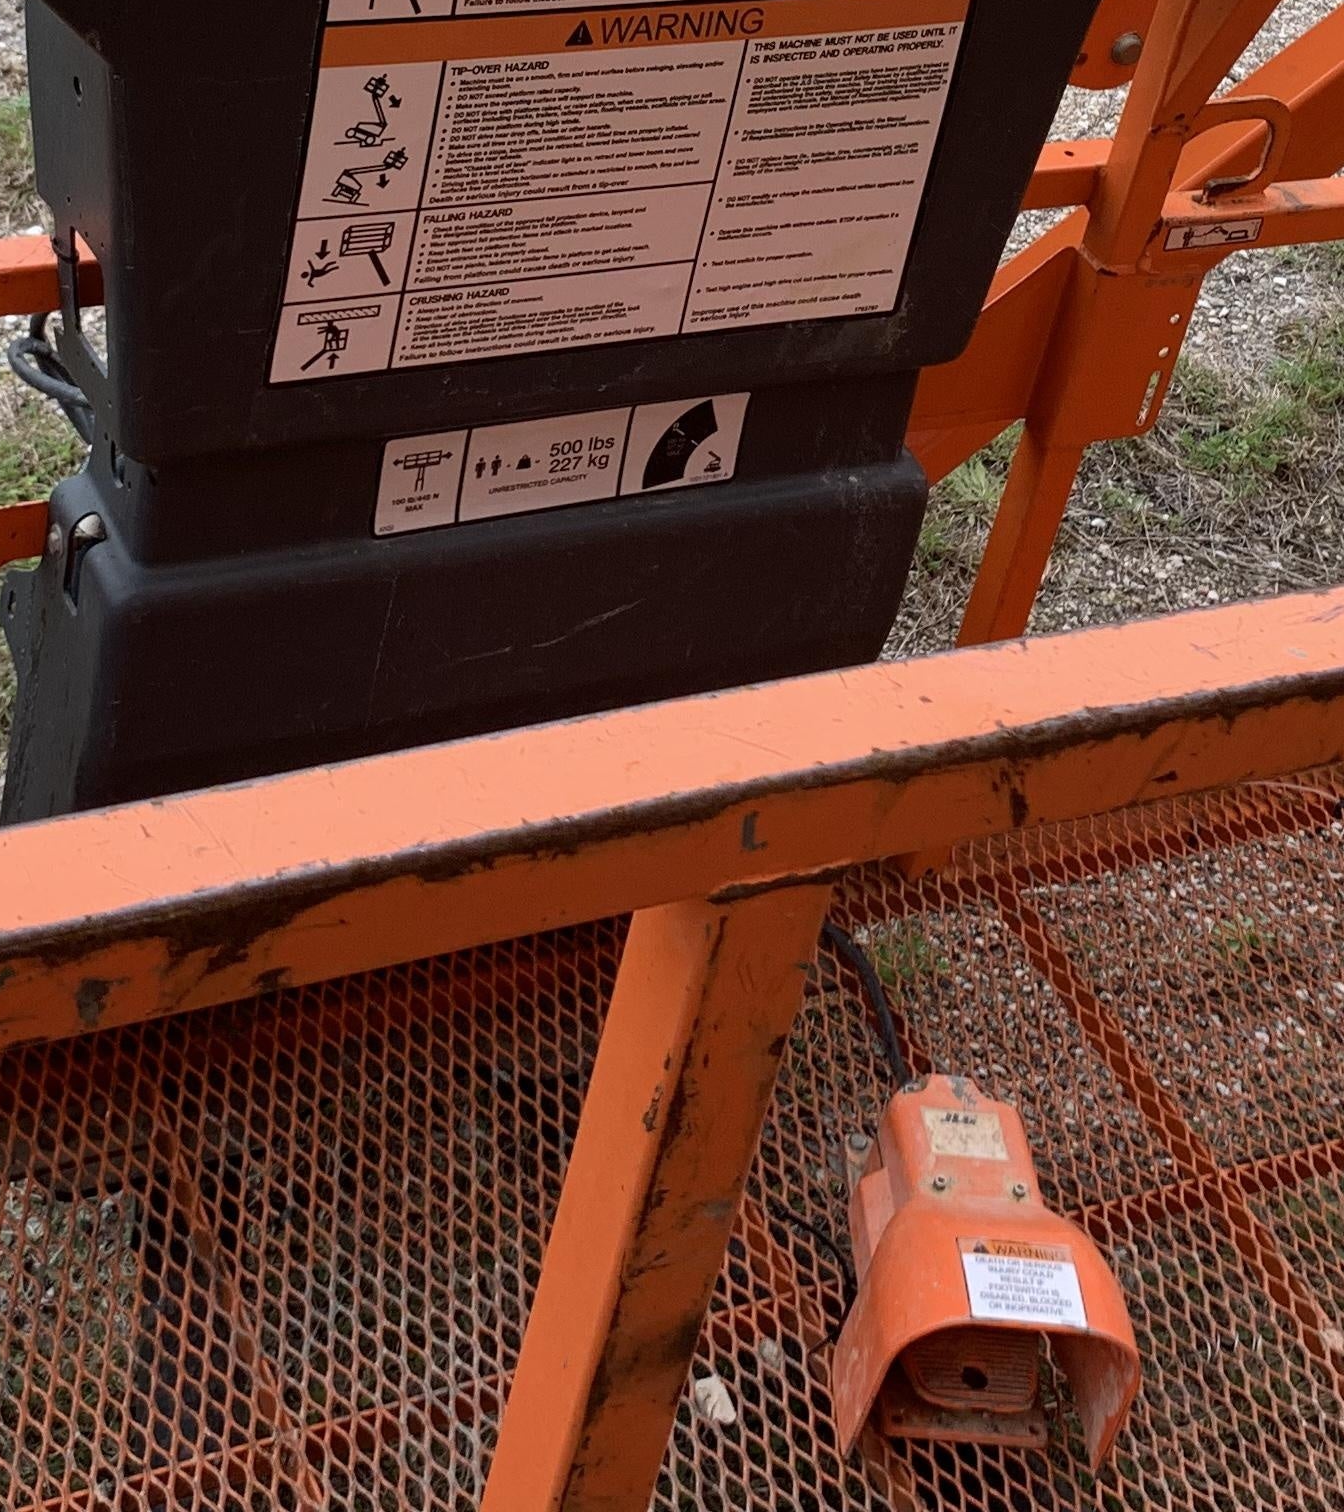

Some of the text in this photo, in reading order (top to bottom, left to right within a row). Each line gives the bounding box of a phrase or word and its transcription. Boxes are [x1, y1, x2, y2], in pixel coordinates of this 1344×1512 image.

[599, 7, 766, 45] WARNING
[753, 25, 958, 52] THIS MACHINE MUST NOT BE USED UNTIL IT
[749, 39, 945, 64] IS INSPECTED AND OPERATING PROPERLY.
[450, 60, 549, 77] TIP-OVER HAZARD
[423, 207, 513, 224] FALLING HAZARD
[409, 287, 510, 306] CRUSHING HAZARD
[548, 434, 616, 457] 500 lbs
[547, 451, 610, 476] 227 kg
[404, 503, 423, 513] MAX
